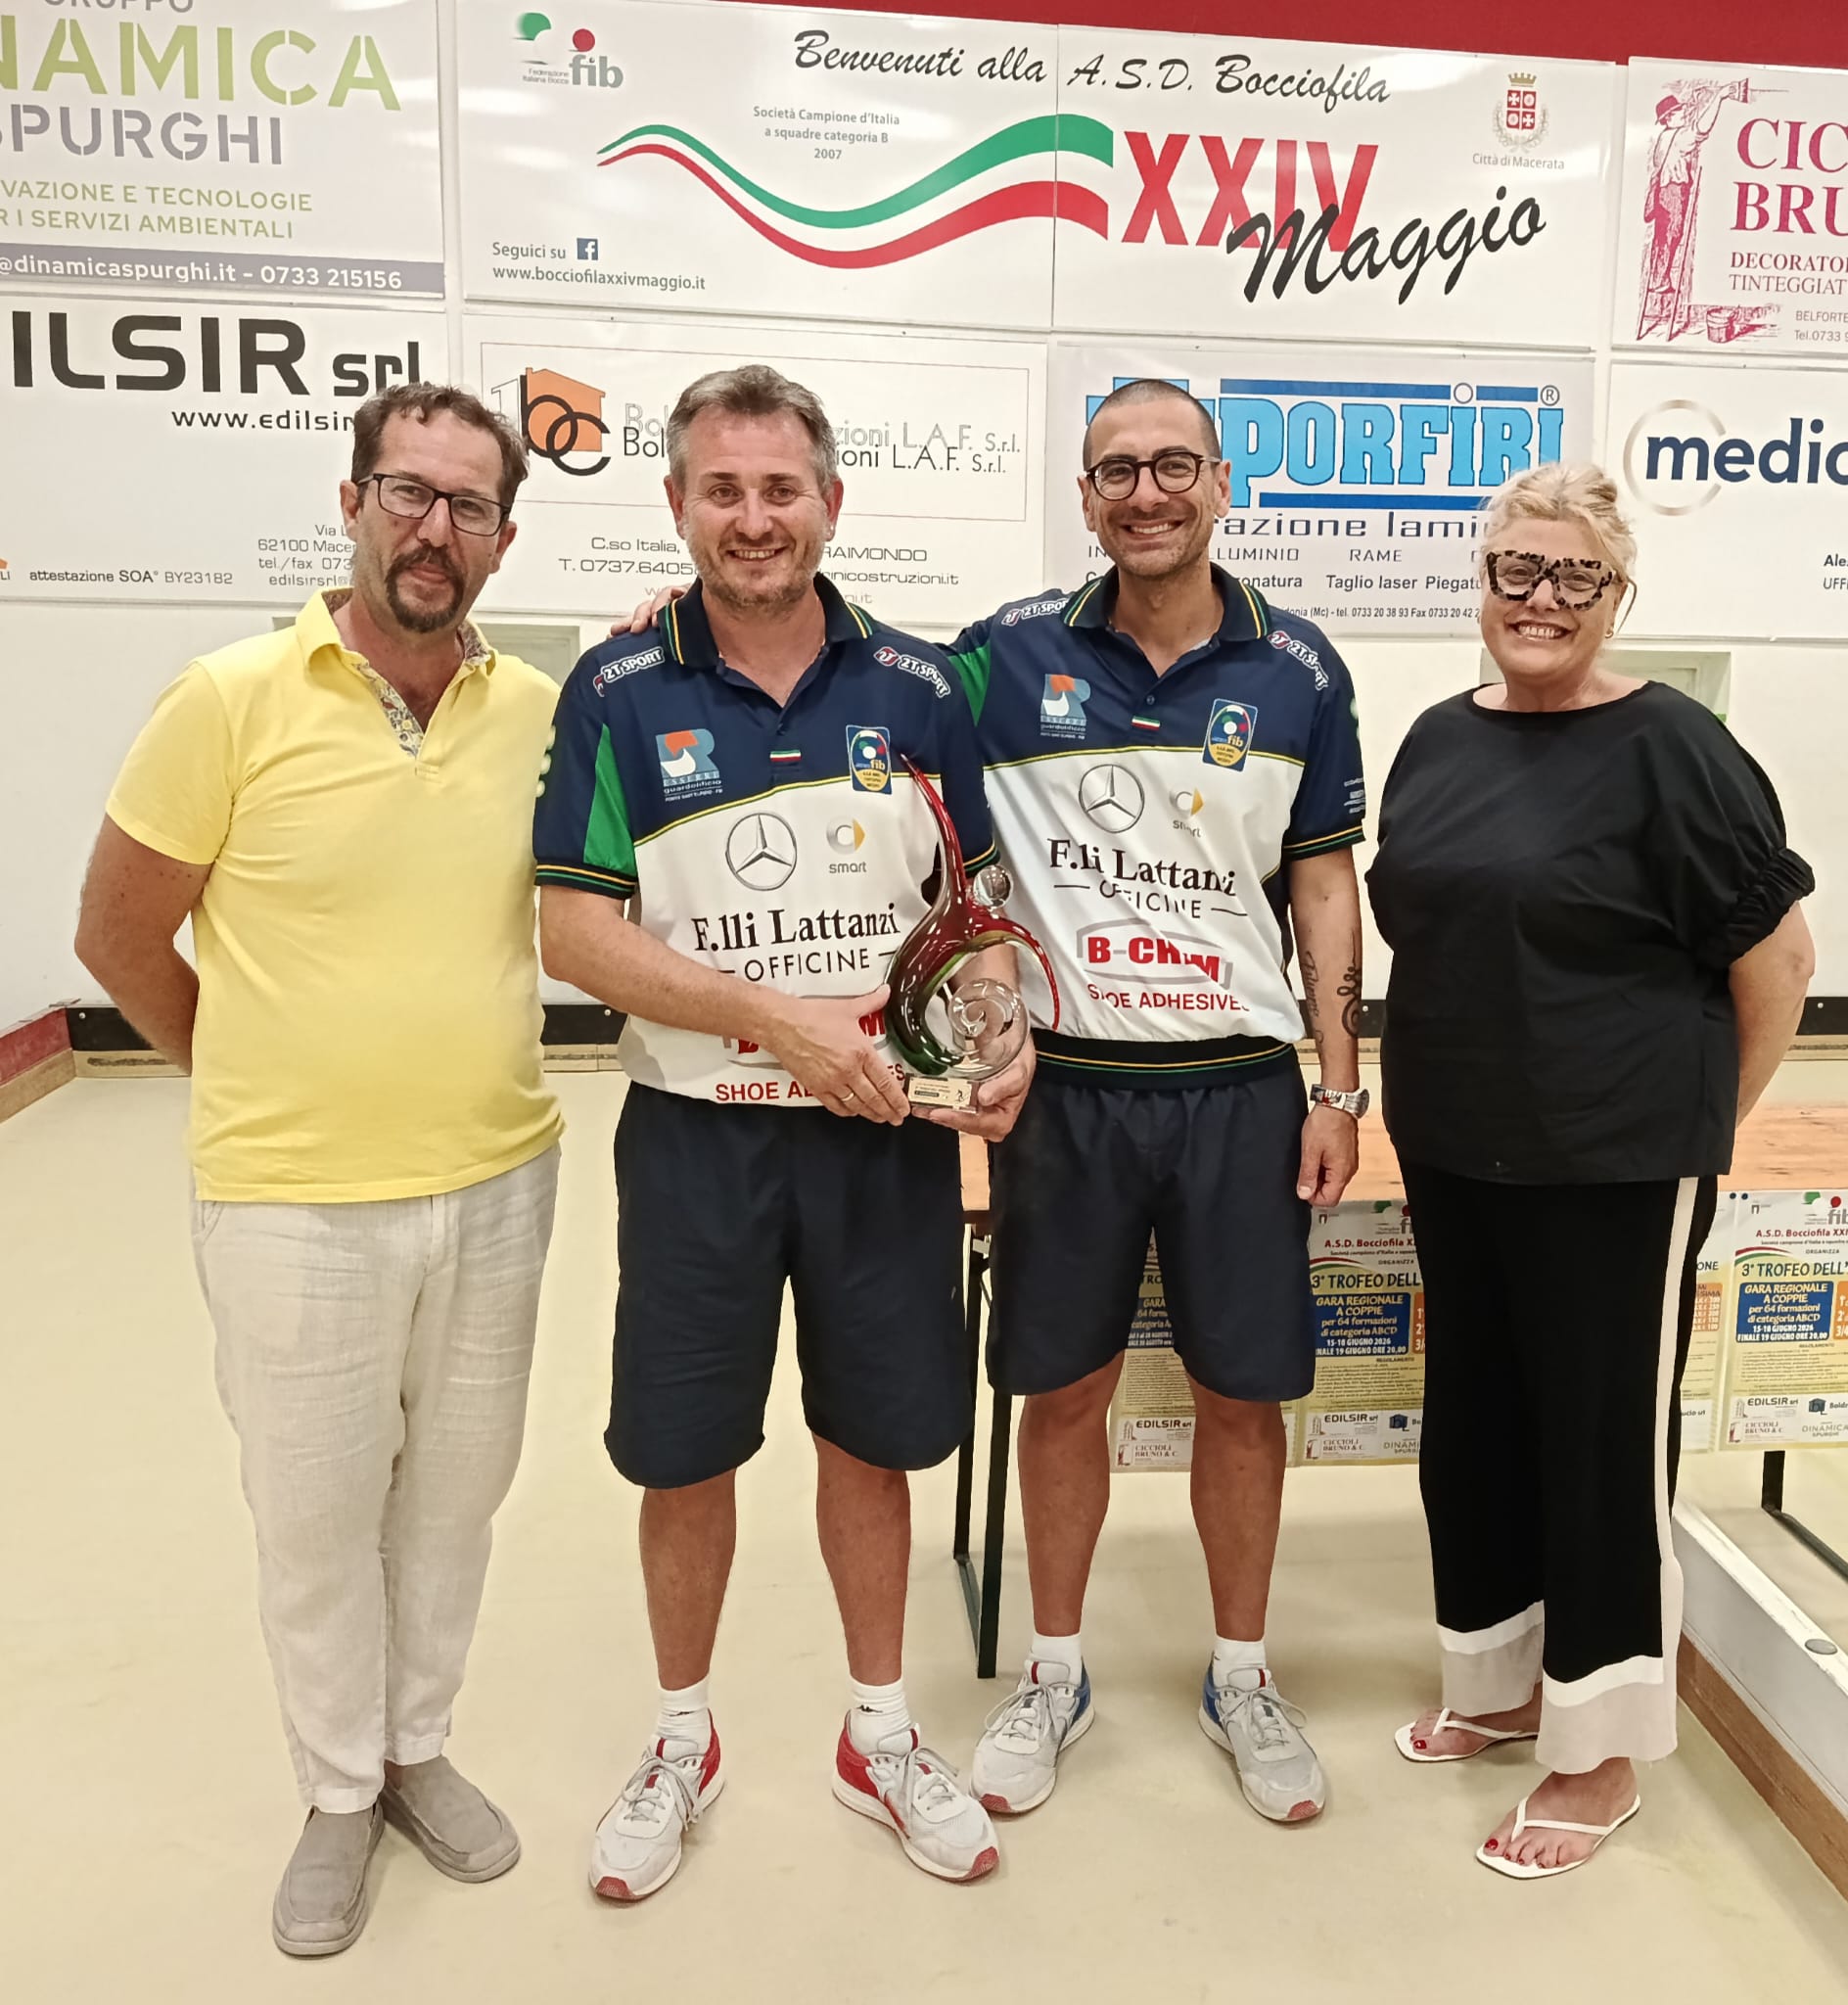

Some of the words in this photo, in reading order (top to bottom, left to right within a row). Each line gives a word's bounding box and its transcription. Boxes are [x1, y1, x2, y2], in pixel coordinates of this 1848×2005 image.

[569, 54, 624, 88] fib
[794, 29, 964, 77] Benvenuti
[978, 46, 1047, 83] alla
[1067, 54, 1193, 93] A.S.D.
[1215, 54, 1391, 114] Bocciofila
[753, 105, 796, 121] Società
[799, 109, 860, 127] Campione
[860, 109, 901, 126] d'Italia
[763, 128, 771, 138] a
[773, 127, 820, 143] squadre
[823, 131, 878, 148] categoria
[880, 132, 889, 143] B
[813, 148, 843, 161] 2007
[1472, 152, 1499, 166] Città
[1500, 155, 1511, 167] di
[1513, 156, 1565, 170] Macerata
[123, 185, 137, 203] E
[145, 186, 313, 211] TECNOLOGIE
[1122, 130, 1378, 252] XXIV
[17, 209, 23, 226] I
[31, 210, 129, 231] SERVIZI
[139, 214, 294, 239] AMBIENTALI
[492, 241, 547, 260] Seguici
[549, 247, 567, 259] su
[1226, 186, 1547, 305] Maggio
[260, 265, 319, 285] 0733
[327, 268, 402, 290] 215156
[492, 264, 706, 293] www.bocciofilaxxivmaggio.it
[333, 341, 420, 397] srl
[902, 421, 974, 451] L.A.F.
[985, 432, 1021, 453] S.r.l.
[893, 443, 960, 472] L.A.F.
[971, 453, 1006, 474] S.r.l.
[314, 524, 336, 536] Via
[1215, 512, 1367, 536] azione
[257, 538, 309, 552] 62100
[591, 536, 631, 551] C.so
[636, 538, 681, 554] Italia,
[1350, 548, 1403, 562] RAME
[558, 558, 577, 572] T.
[579, 559, 699, 576] 0737.6405
[29, 570, 115, 583] attestazione
[164, 572, 233, 585] BY23182
[1326, 575, 1373, 592] Taglio
[1379, 576, 1418, 589] laser
[1311, 606, 1329, 619] (Mc)
[1352, 607, 1370, 618] 0733
[1374, 608, 1384, 619] 20
[1386, 608, 1397, 618] 38
[1399, 608, 1409, 619] 93
[1411, 609, 1426, 619] Fax
[1429, 608, 1448, 619] 0733
[1451, 608, 1460, 619] 20
[1462, 609, 1473, 619] 42
[828, 862, 867, 874] smart
[691, 911, 760, 952] F.lli
[767, 902, 901, 946] Lattanzi
[744, 949, 870, 982] OFFICINE
[716, 1081, 780, 1102] SHOE
[1786, 1228, 1830, 1237] Bocciofila
[1357, 1237, 1405, 1248] Bocciofila
[1757, 1262, 1810, 1277] TROFEO
[1328, 1274, 1384, 1288] TROFEO
[1744, 1283, 1773, 1294] GARA
[1773, 1282, 1828, 1293] REGIONALE
[1316, 1296, 1344, 1307] GARA
[1346, 1295, 1404, 1306] REGIONALE
[1763, 1294, 1771, 1304] A
[1772, 1293, 1809, 1303] COPPIE
[1336, 1307, 1344, 1317] A
[1345, 1306, 1384, 1316] COPPIE
[1748, 1306, 1763, 1315] per
[1764, 1304, 1776, 1313] 64
[1795, 1313, 1821, 1322] ABCD
[1321, 1320, 1336, 1329] per
[1329, 1328, 1371, 1338] categoria
[1747, 1397, 1788, 1406] EDILSIR
[1135, 1420, 1180, 1428] EDILSIR
[1324, 1414, 1367, 1422] EDILSIR
